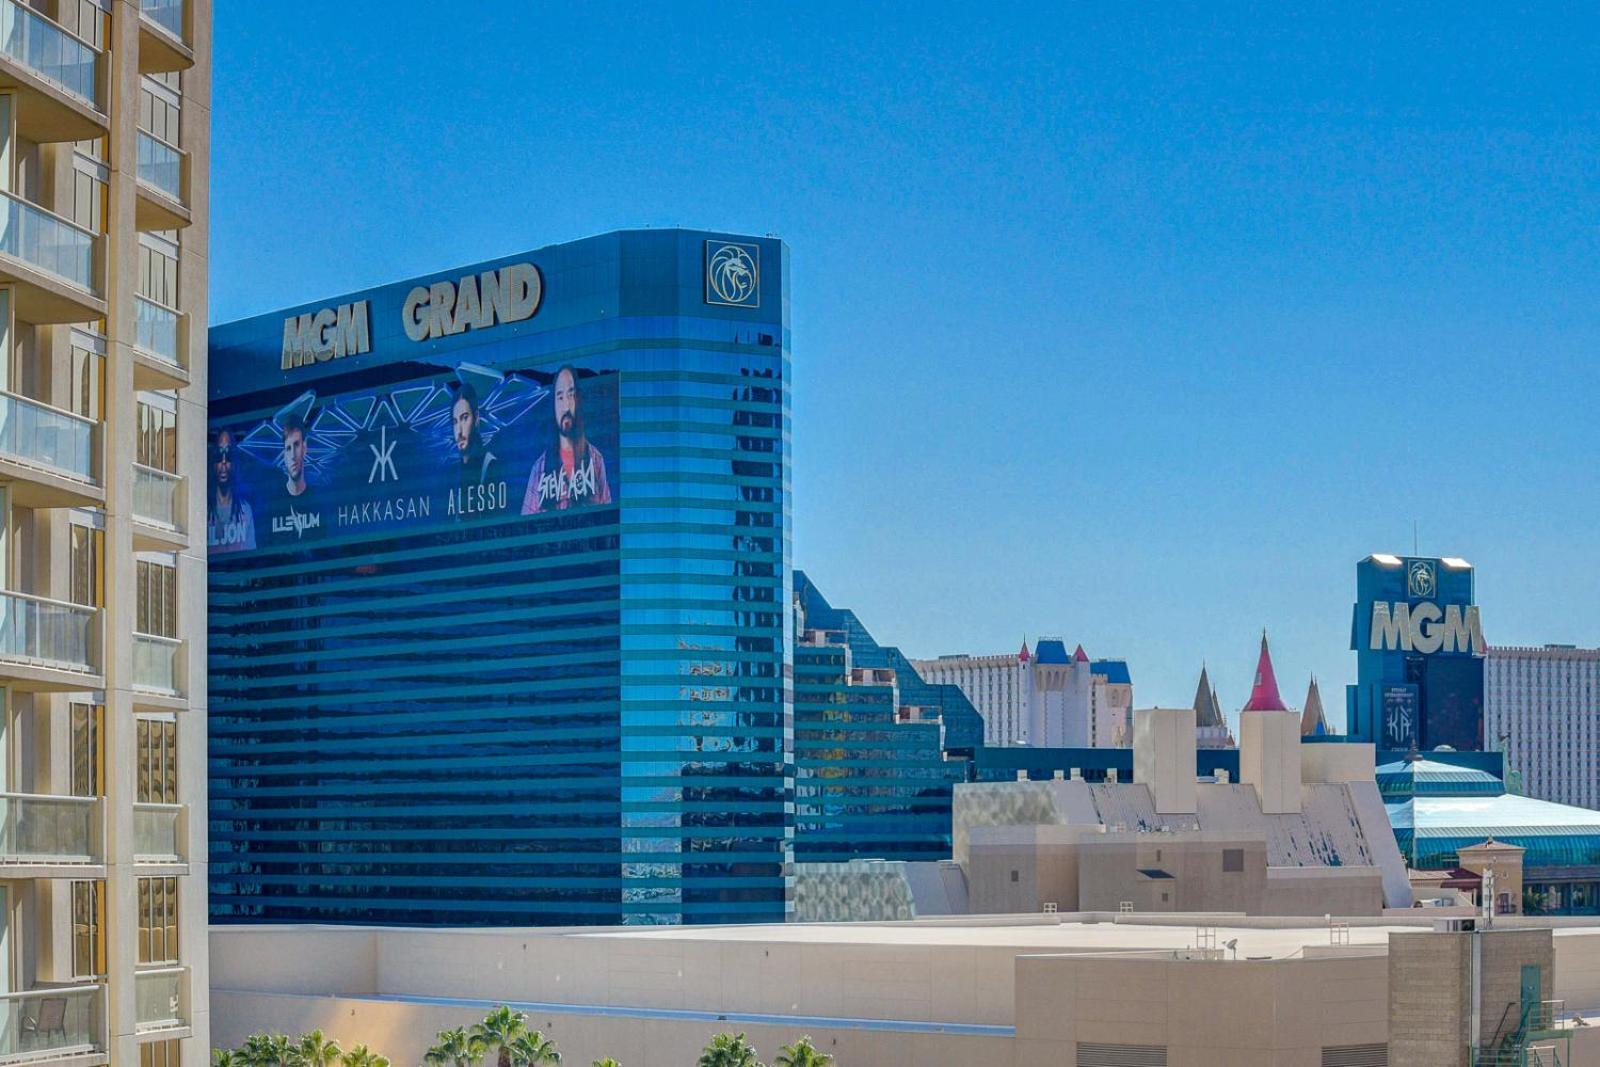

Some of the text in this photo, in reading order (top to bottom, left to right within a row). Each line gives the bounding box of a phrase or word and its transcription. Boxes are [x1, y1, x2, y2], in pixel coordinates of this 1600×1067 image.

[281, 262, 541, 370] MGM GRAND
[447, 481, 507, 516] ALESSO
[538, 467, 567, 508] STEVE
[338, 496, 430, 528] HAKKASAN
[220, 523, 246, 545] JON
[1370, 601, 1483, 654] MGM
